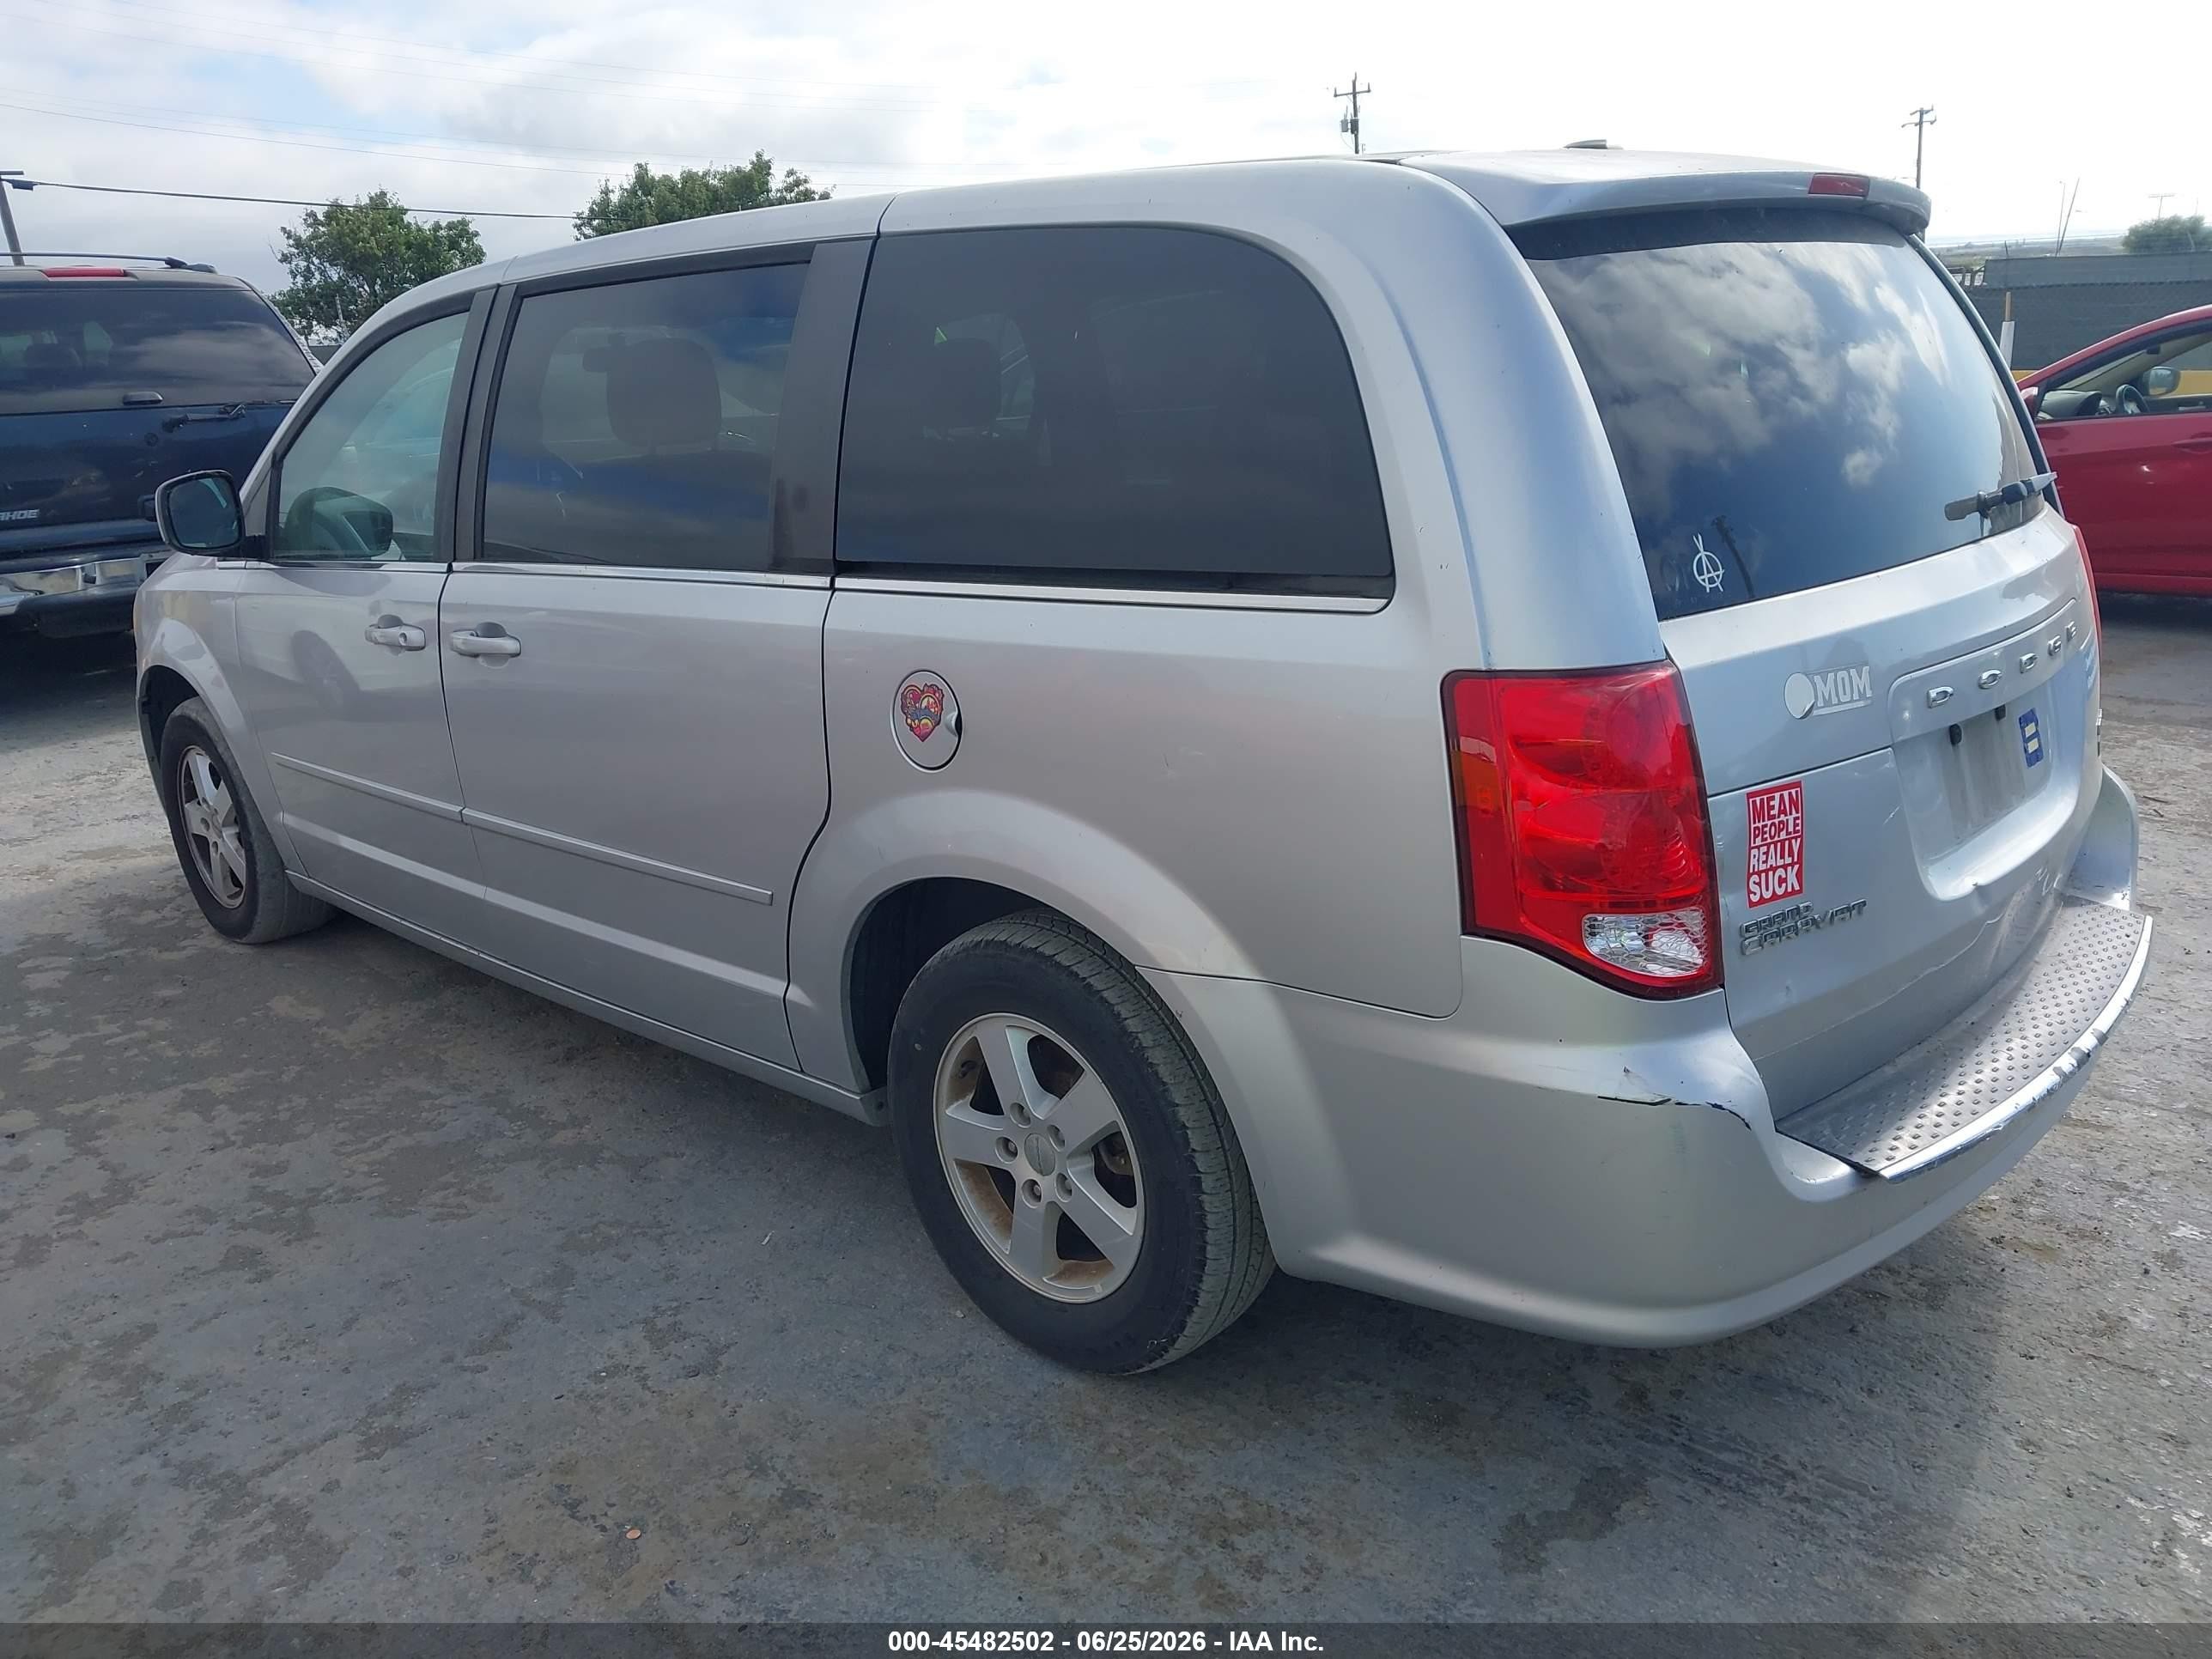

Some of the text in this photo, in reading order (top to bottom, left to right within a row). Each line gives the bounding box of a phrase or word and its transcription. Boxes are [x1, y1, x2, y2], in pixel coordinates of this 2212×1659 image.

[1927, 621, 2077, 708] DODGE
[1813, 666, 1873, 707] MOM
[1751, 790, 1800, 825] MEAN
[1753, 816, 1801, 845] PEOPLE
[1749, 837, 1802, 872] REALLY
[1748, 864, 1801, 902] SUCK
[1739, 901, 1814, 938] GRAND
